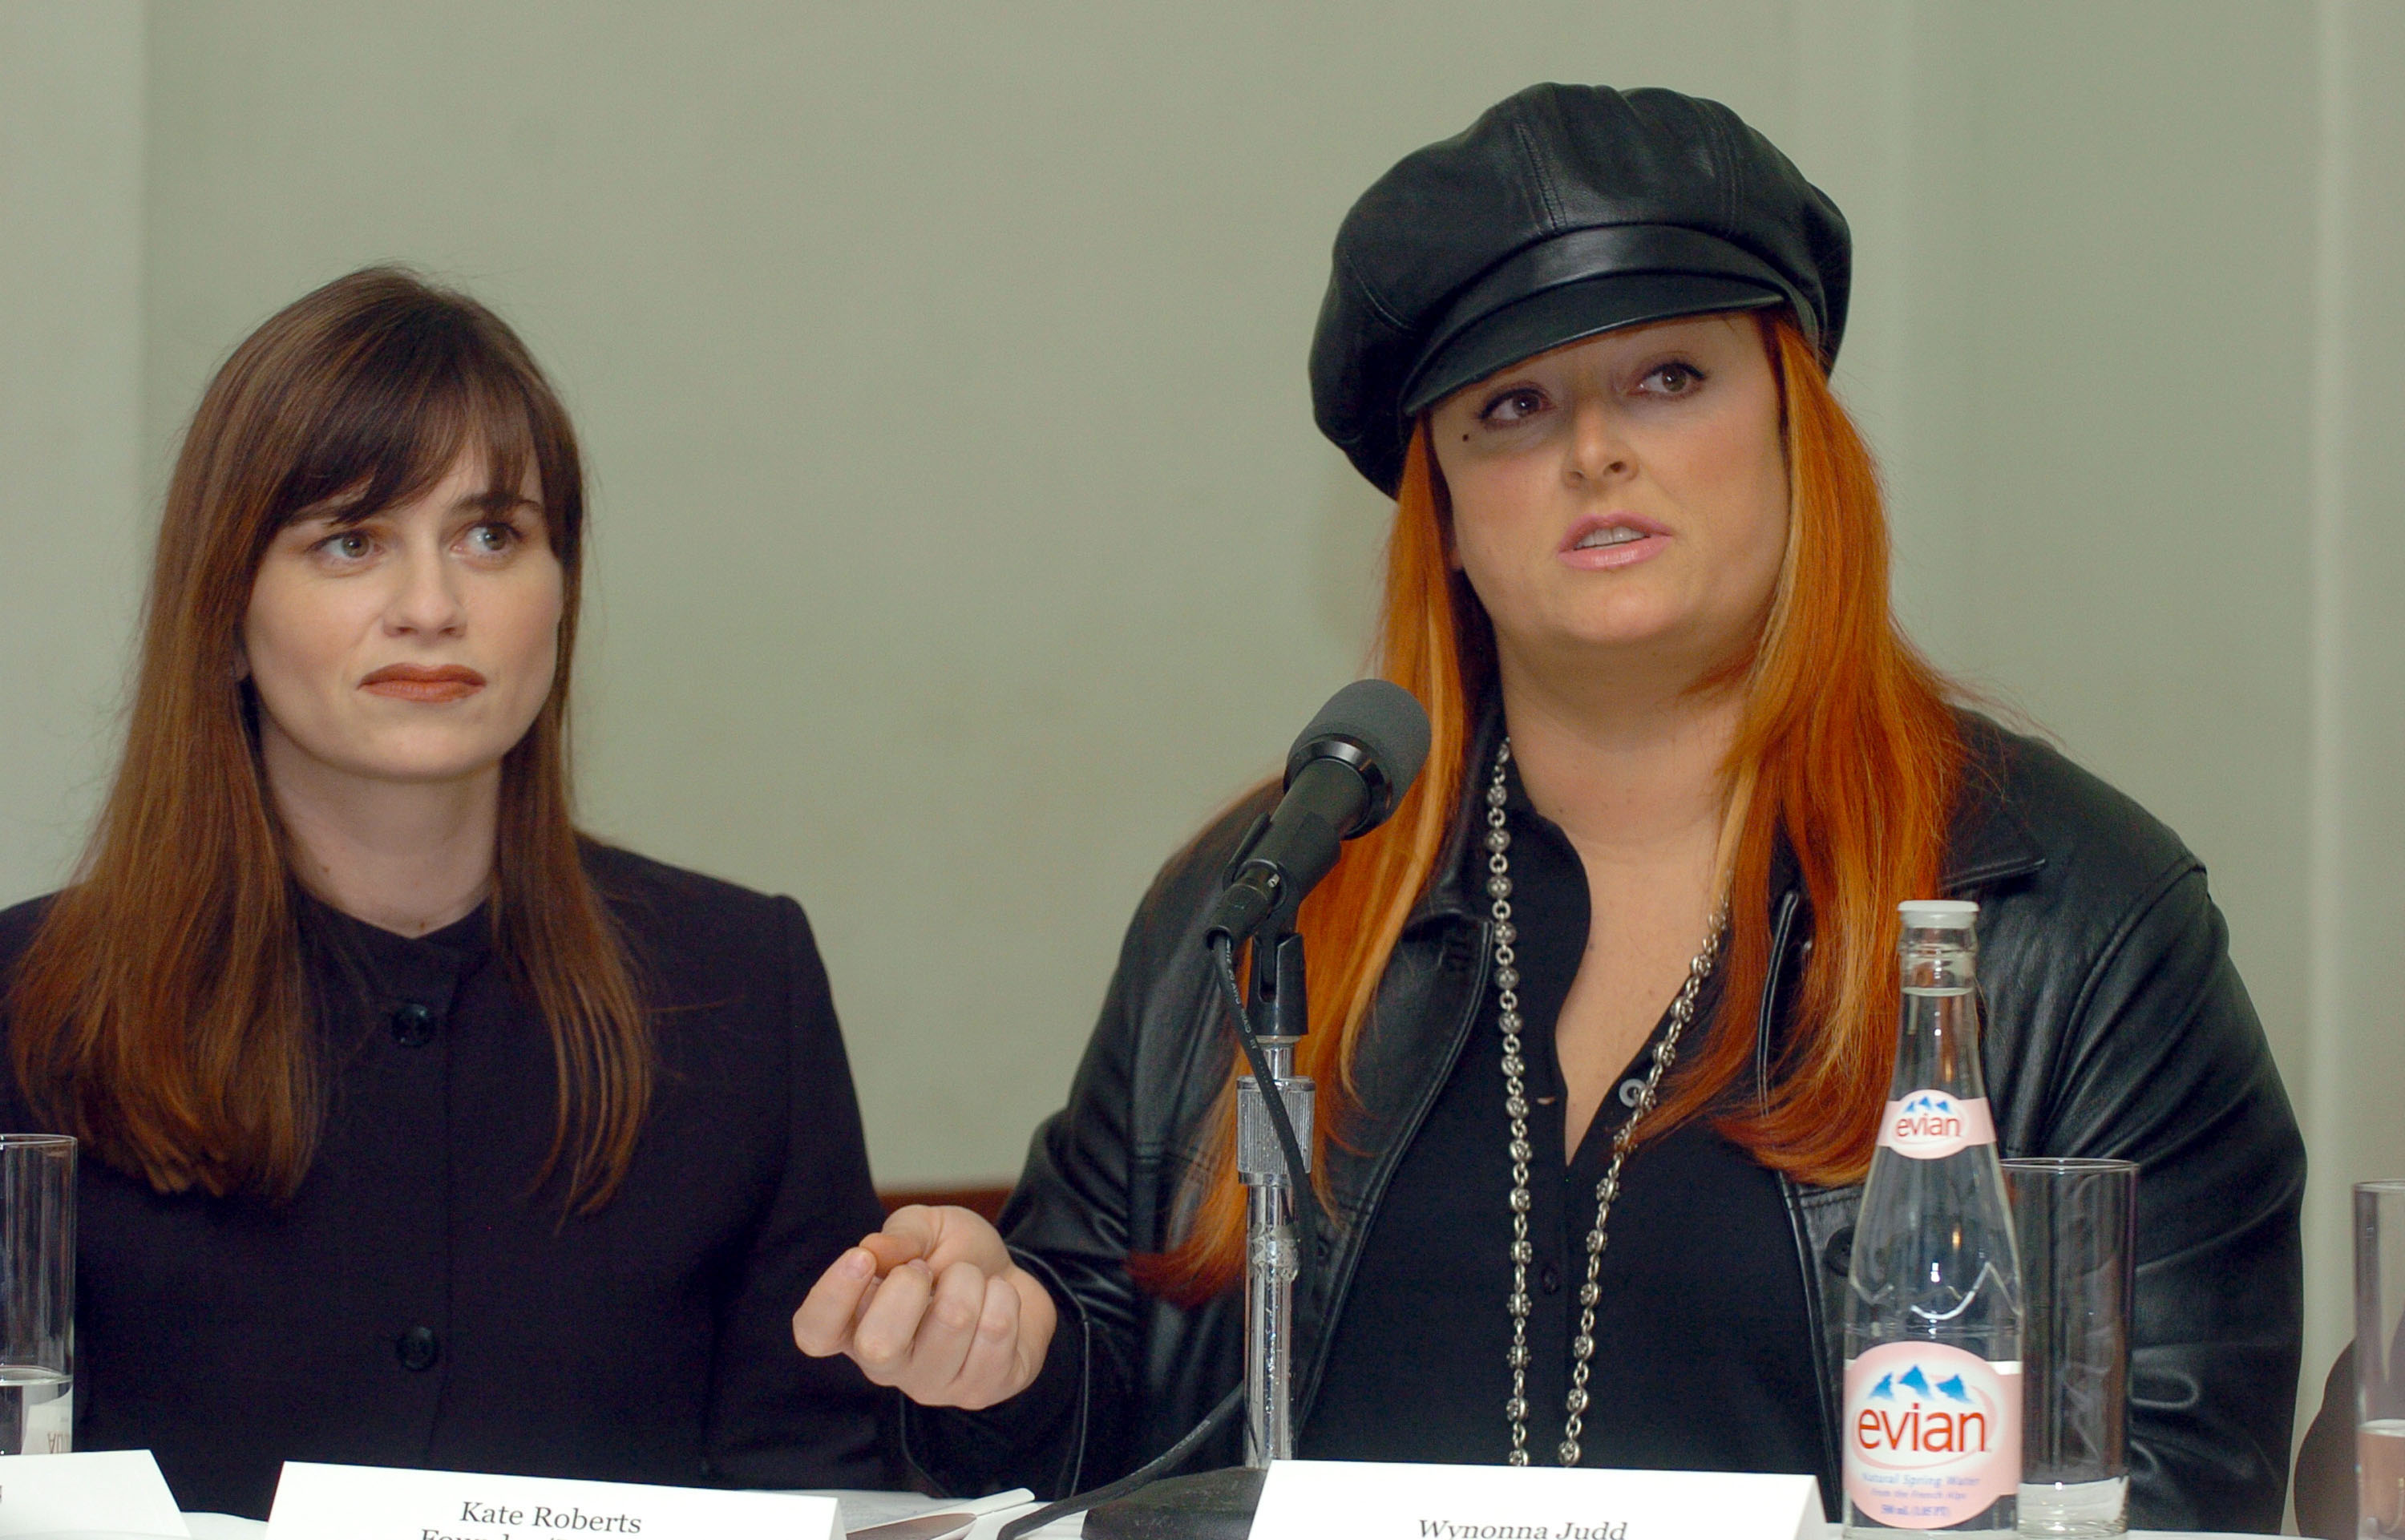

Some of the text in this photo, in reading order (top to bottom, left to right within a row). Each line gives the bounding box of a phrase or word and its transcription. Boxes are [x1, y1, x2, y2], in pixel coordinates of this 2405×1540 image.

[1896, 1113, 1961, 1137] evian
[1858, 1403, 1986, 1453] evian
[459, 1501, 641, 1534] Kate Roberts
[1419, 1520, 1628, 1540] Wynonna Judd
